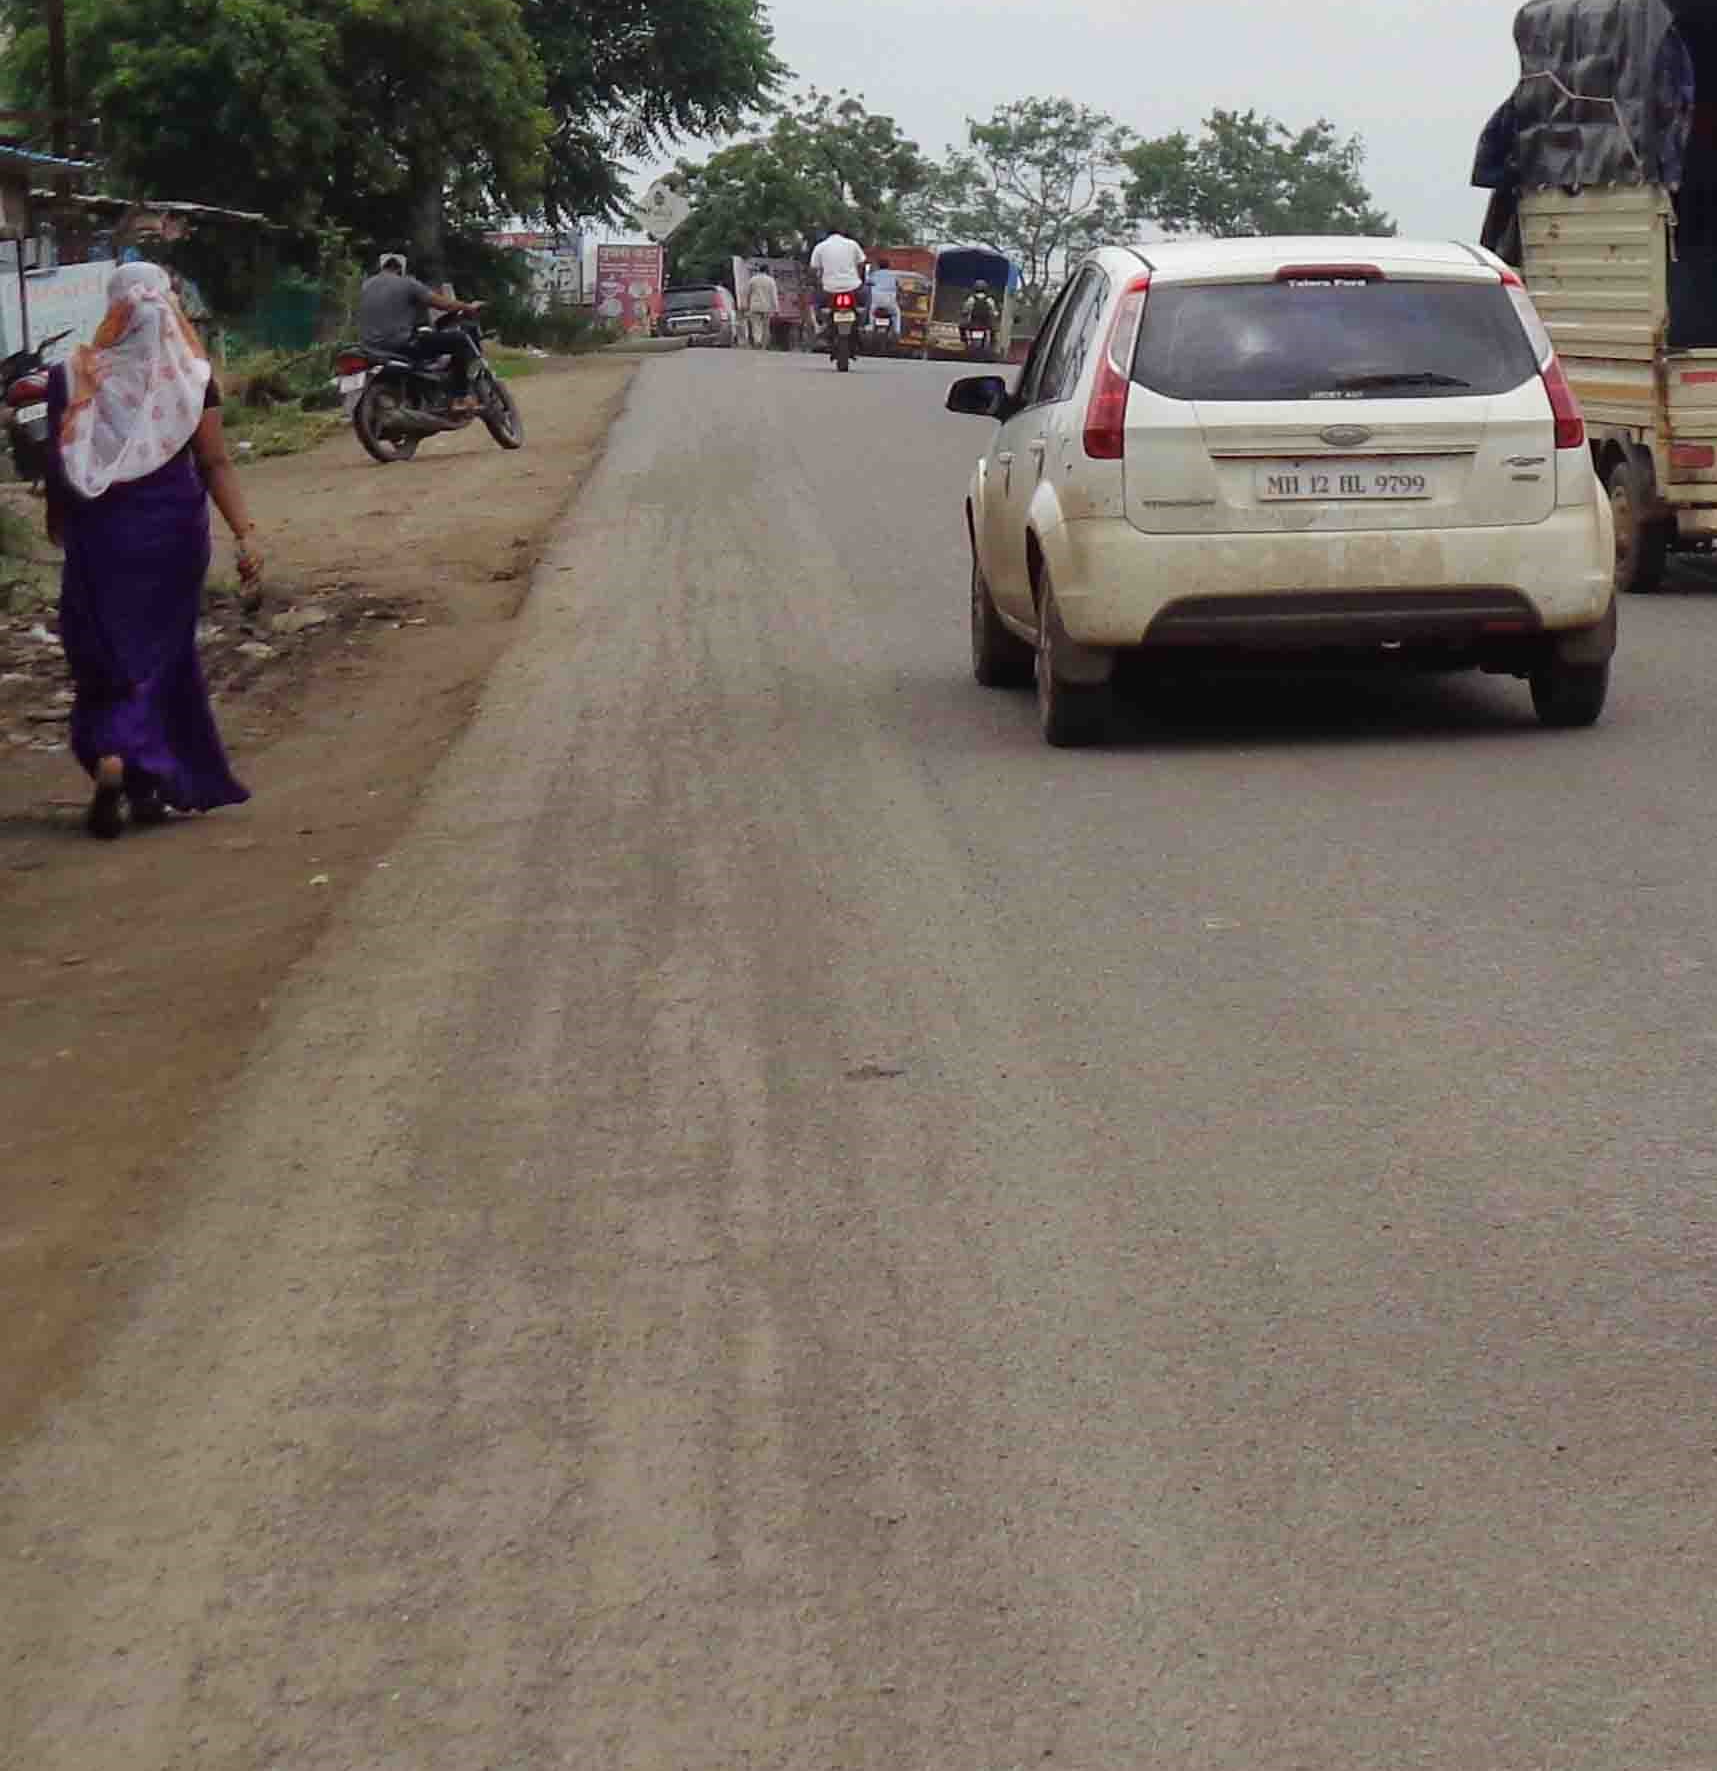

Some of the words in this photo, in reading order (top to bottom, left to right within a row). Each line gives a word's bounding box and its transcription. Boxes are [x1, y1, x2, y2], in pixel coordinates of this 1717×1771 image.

[1268, 474, 1299, 495] MH
[1312, 474, 1329, 494] 12
[1375, 473, 1425, 494] 9799
